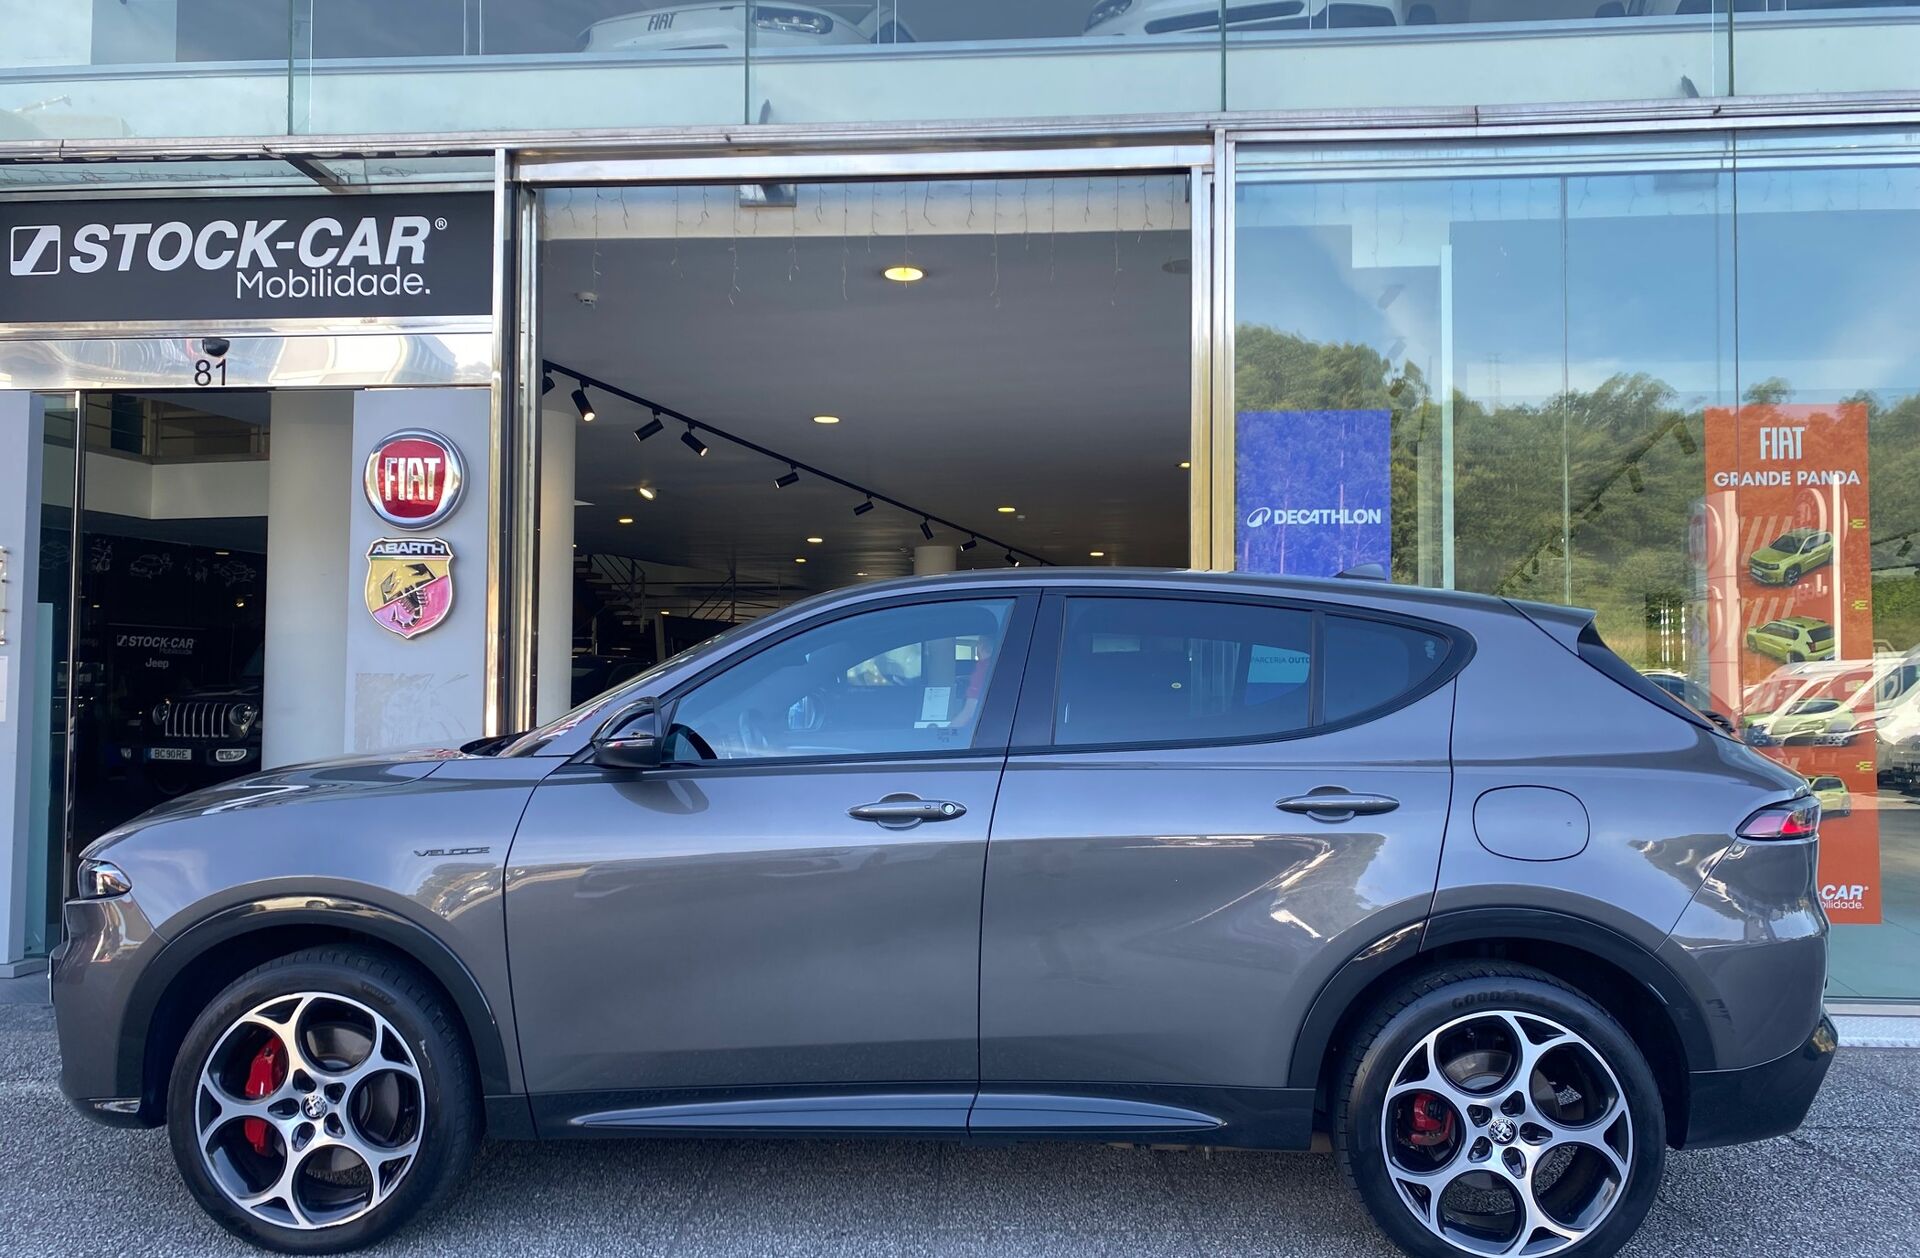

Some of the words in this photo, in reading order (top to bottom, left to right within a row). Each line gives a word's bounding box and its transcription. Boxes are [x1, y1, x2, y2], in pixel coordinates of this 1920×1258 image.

[648, 12, 677, 31] FIAT
[236, 266, 431, 299] Mobilidade.
[194, 359, 227, 387] 81
[1760, 426, 1805, 460] FIAT
[384, 457, 441, 501] FIAT
[1713, 470, 1792, 487] GRANDE
[1797, 469, 1861, 486] PANDA
[1273, 508, 1382, 525] DECATHLON
[372, 542, 444, 555] ABARTH
[128, 635, 195, 649] STOCK-CAR
[144, 657, 169, 670] Jeep
